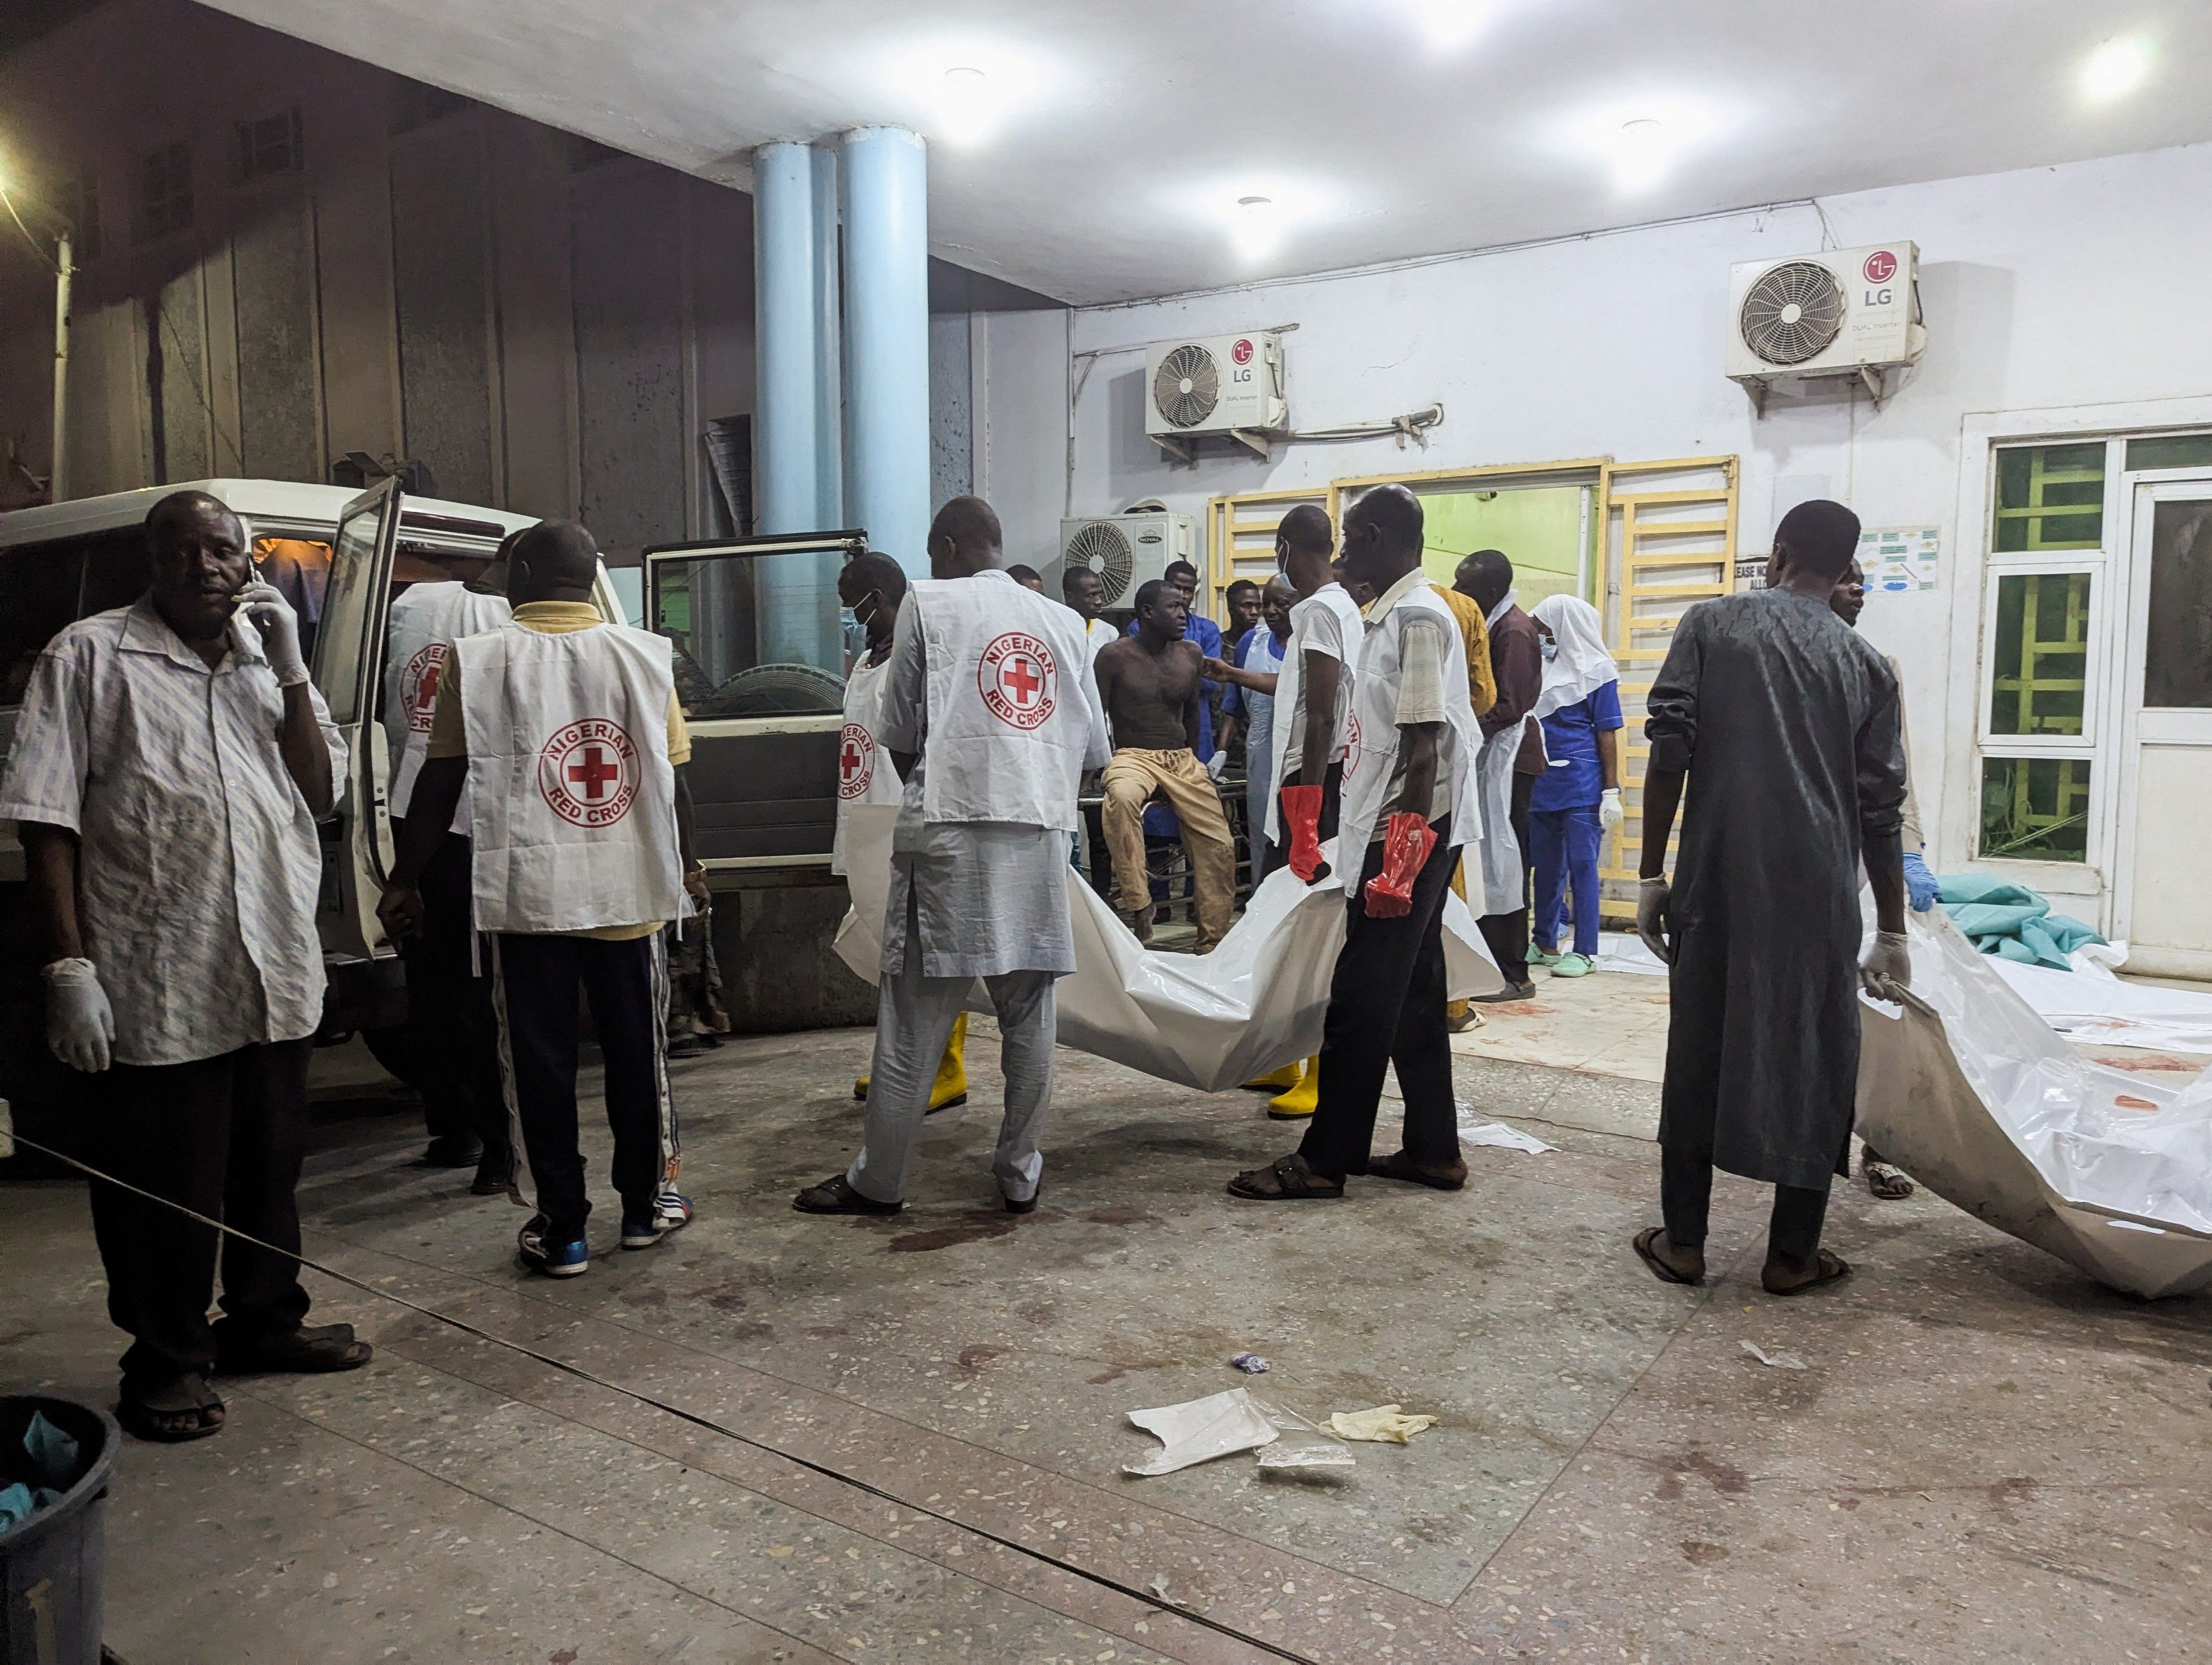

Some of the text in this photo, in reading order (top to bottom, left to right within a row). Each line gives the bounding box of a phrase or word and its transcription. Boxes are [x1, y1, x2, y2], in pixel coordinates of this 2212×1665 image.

[1865, 288, 1891, 306] LG
[1234, 369, 1251, 382] LG
[986, 637, 1054, 675] NIGERIAN
[986, 688, 1053, 725] RED CROSS
[546, 724, 634, 761] NIGERIAN
[842, 770, 869, 796] CROSS
[548, 784, 633, 823] RED CROSS
